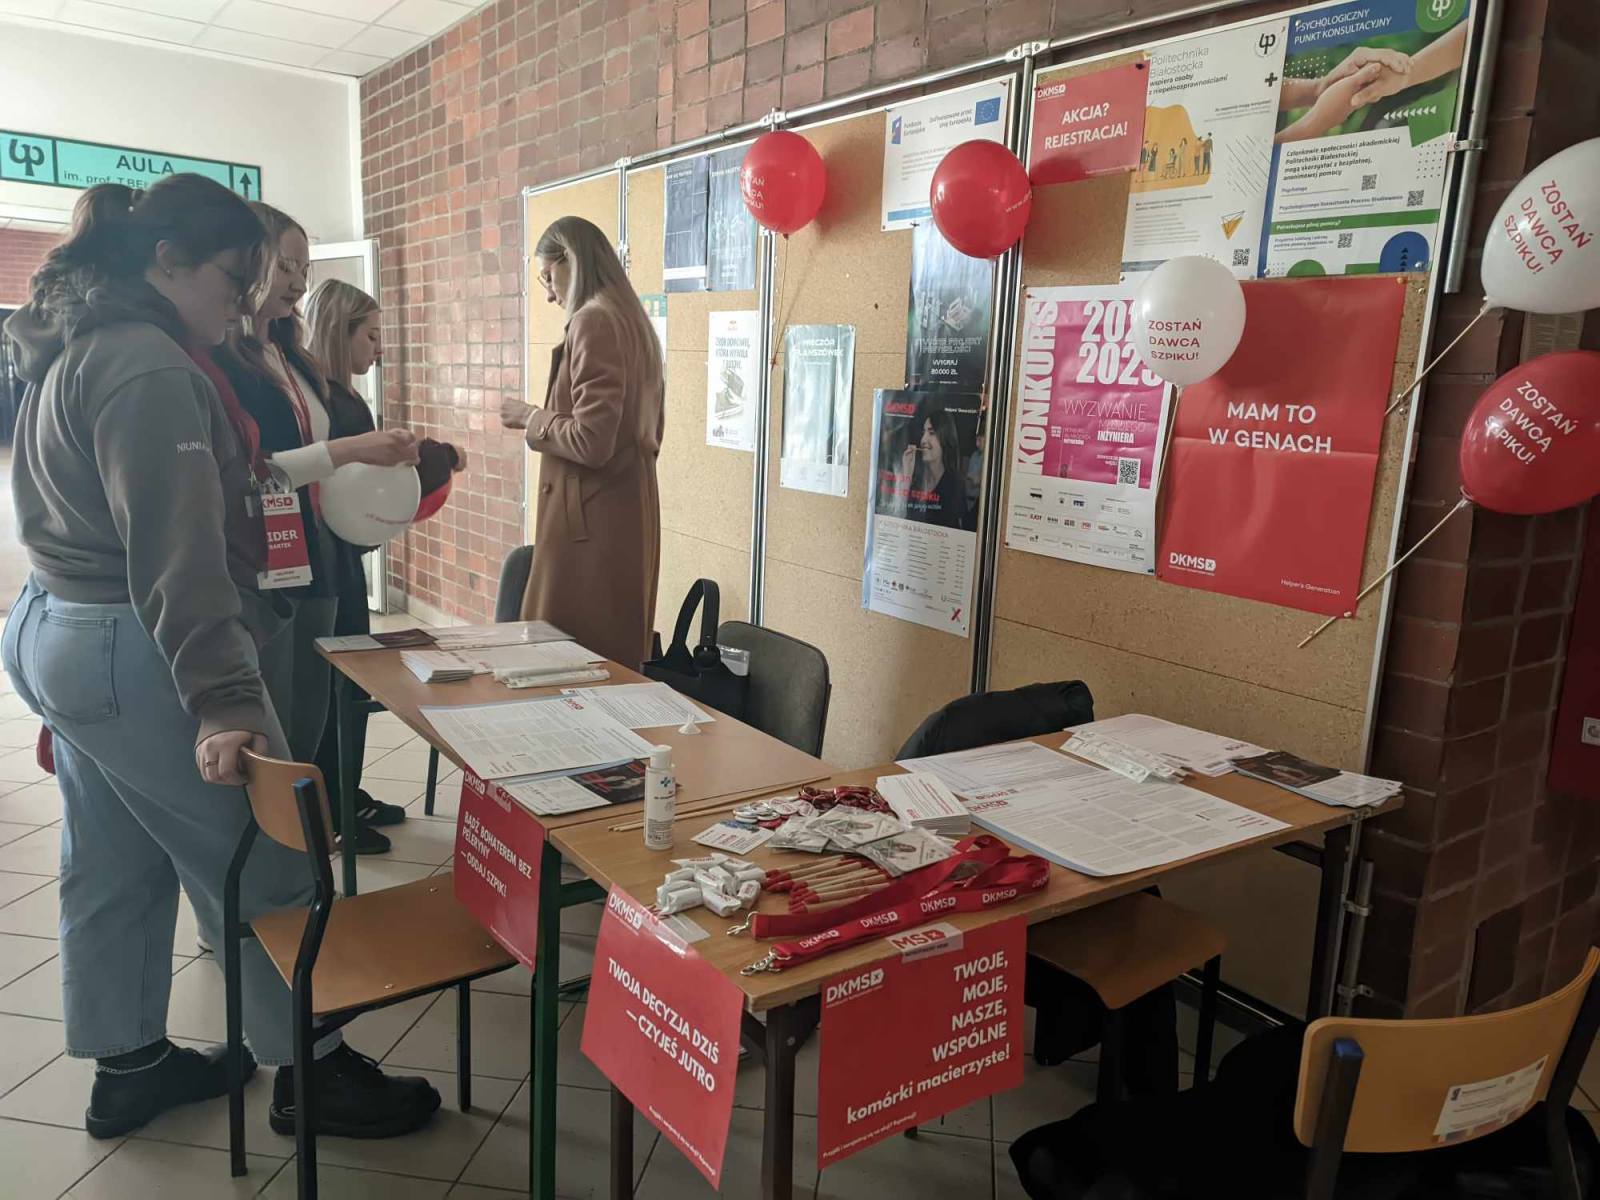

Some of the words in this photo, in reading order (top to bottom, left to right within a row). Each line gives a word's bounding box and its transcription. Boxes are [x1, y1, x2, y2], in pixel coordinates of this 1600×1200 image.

[1294, 30, 1322, 46] PUNKT
[1322, 16, 1393, 40] KONSULTACYJNY
[1150, 46, 1210, 66] Politechnika
[1037, 84, 1061, 99] DKMS
[1174, 73, 1195, 85] osoby
[1061, 102, 1110, 126] AKCJA?
[1044, 120, 1129, 150] REJESTRACJA!
[1357, 136, 1400, 149] akademickiej
[116, 154, 175, 175] AULA
[1541, 179, 1595, 250] ZOSTAŃ
[1520, 196, 1565, 265] DAWCA
[1504, 215, 1545, 275] SZPIKU!
[1148, 317, 1202, 332] ZOSTAŃ
[1149, 335, 1200, 348] DAWCA
[1151, 350, 1200, 361] SZPIKU!
[1017, 300, 1059, 476] KONKURS
[1062, 398, 1149, 421] WYZWANIE
[1227, 401, 1280, 423] MAM
[1285, 404, 1317, 425] TO
[1515, 379, 1580, 436] ZOSTAŃ
[1097, 430, 1135, 444] INŻYNIERA
[1498, 397, 1553, 454] DAWCA
[1208, 427, 1230, 446] W
[1233, 430, 1333, 455] GENACH
[1169, 552, 1206, 571] DKMS
[464, 770, 483, 795] DKMS
[462, 827, 491, 859] PELERYNY
[480, 826, 518, 868] BOHATEREM
[517, 861, 533, 880] BEZ
[485, 873, 508, 898] SZPIK!
[982, 890, 1011, 904] DKMS
[608, 892, 636, 922] DKMS
[920, 898, 951, 914] DKMS
[861, 913, 890, 930] DKMS
[799, 932, 832, 949] DKMS
[954, 951, 1009, 982] TWOJE,
[826, 972, 872, 1005] DKMS
[962, 974, 1009, 1004] MOJE,
[608, 957, 641, 1001] TWOJA
[642, 990, 692, 1042] DECYZJA
[693, 1025, 720, 1066] DZIŚ
[951, 999, 1008, 1031] NASZE,
[931, 1021, 1008, 1063] WSPÓLNE
[678, 1048, 716, 1093] JUTRO
[847, 1081, 914, 1125] komórki
[917, 1042, 1012, 1094] macierzyste!
